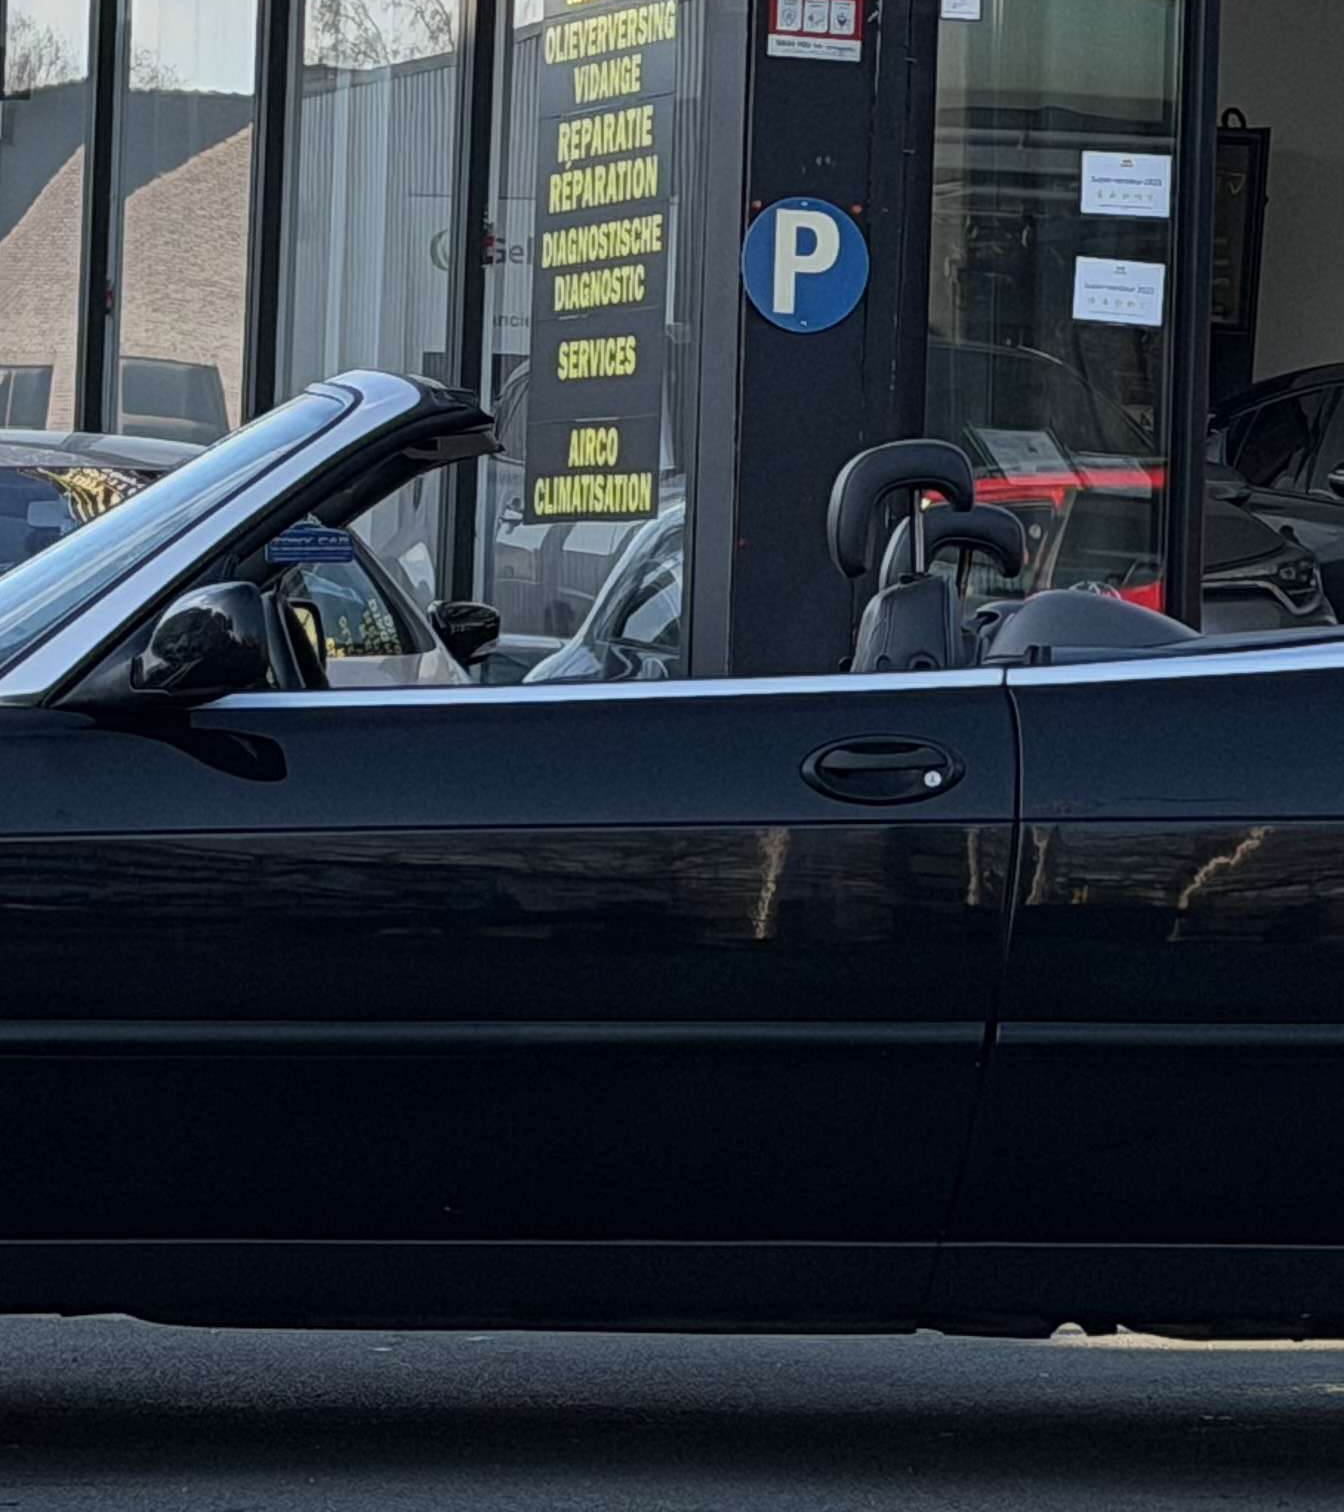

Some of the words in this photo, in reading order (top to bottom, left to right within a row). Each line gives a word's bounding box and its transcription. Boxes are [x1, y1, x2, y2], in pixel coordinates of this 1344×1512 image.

[544, 0, 676, 65] OLIEVERVERSING
[573, 53, 642, 104] VIDANGE
[557, 104, 654, 163] REPARATIE
[548, 154, 659, 214] RÉPARATION
[541, 214, 663, 268] DIAGNOSTISCHE
[772, 208, 841, 315] P
[554, 264, 646, 312] DIAGNOSTIC
[557, 336, 637, 380] SERVICES
[567, 427, 619, 467] AIRCO
[533, 472, 654, 516] CLIMATISATION
